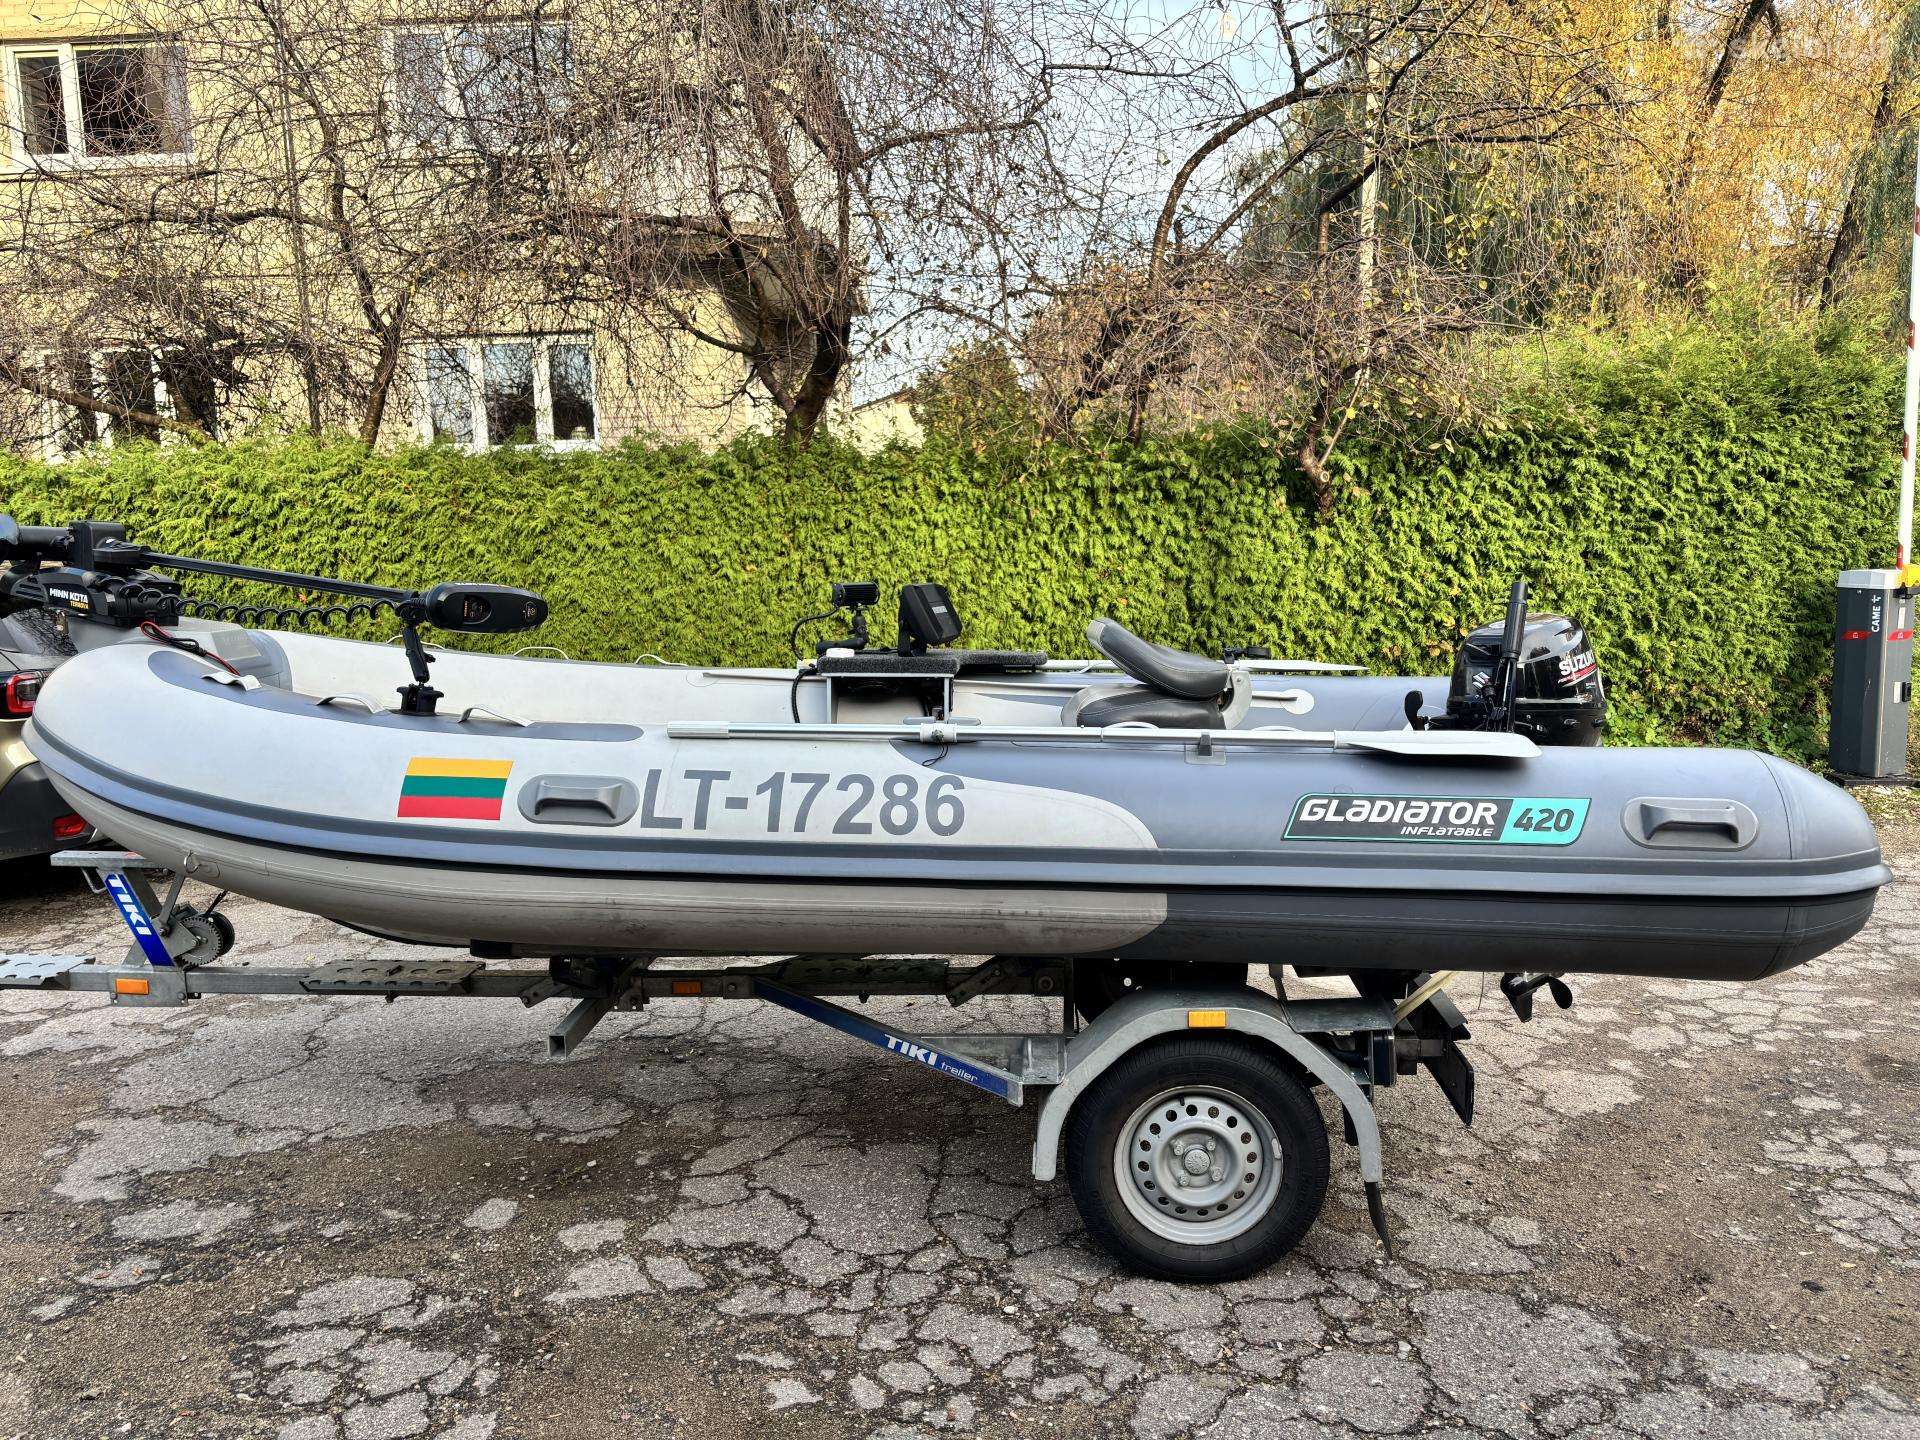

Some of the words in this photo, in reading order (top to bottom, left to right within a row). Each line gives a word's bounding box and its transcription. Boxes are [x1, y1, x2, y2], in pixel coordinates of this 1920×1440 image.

[49, 588, 69, 600] MINN
[69, 592, 89, 604] KOTA
[1871, 605, 1881, 633] CAME
[640, 768, 966, 836] LT-17286
[1299, 798, 1499, 825] GLADIATOR
[1513, 807, 1575, 832] 420
[1400, 826, 1493, 837] INFLATABLE
[108, 873, 152, 935] TIKI
[884, 1034, 938, 1066] TIKI
